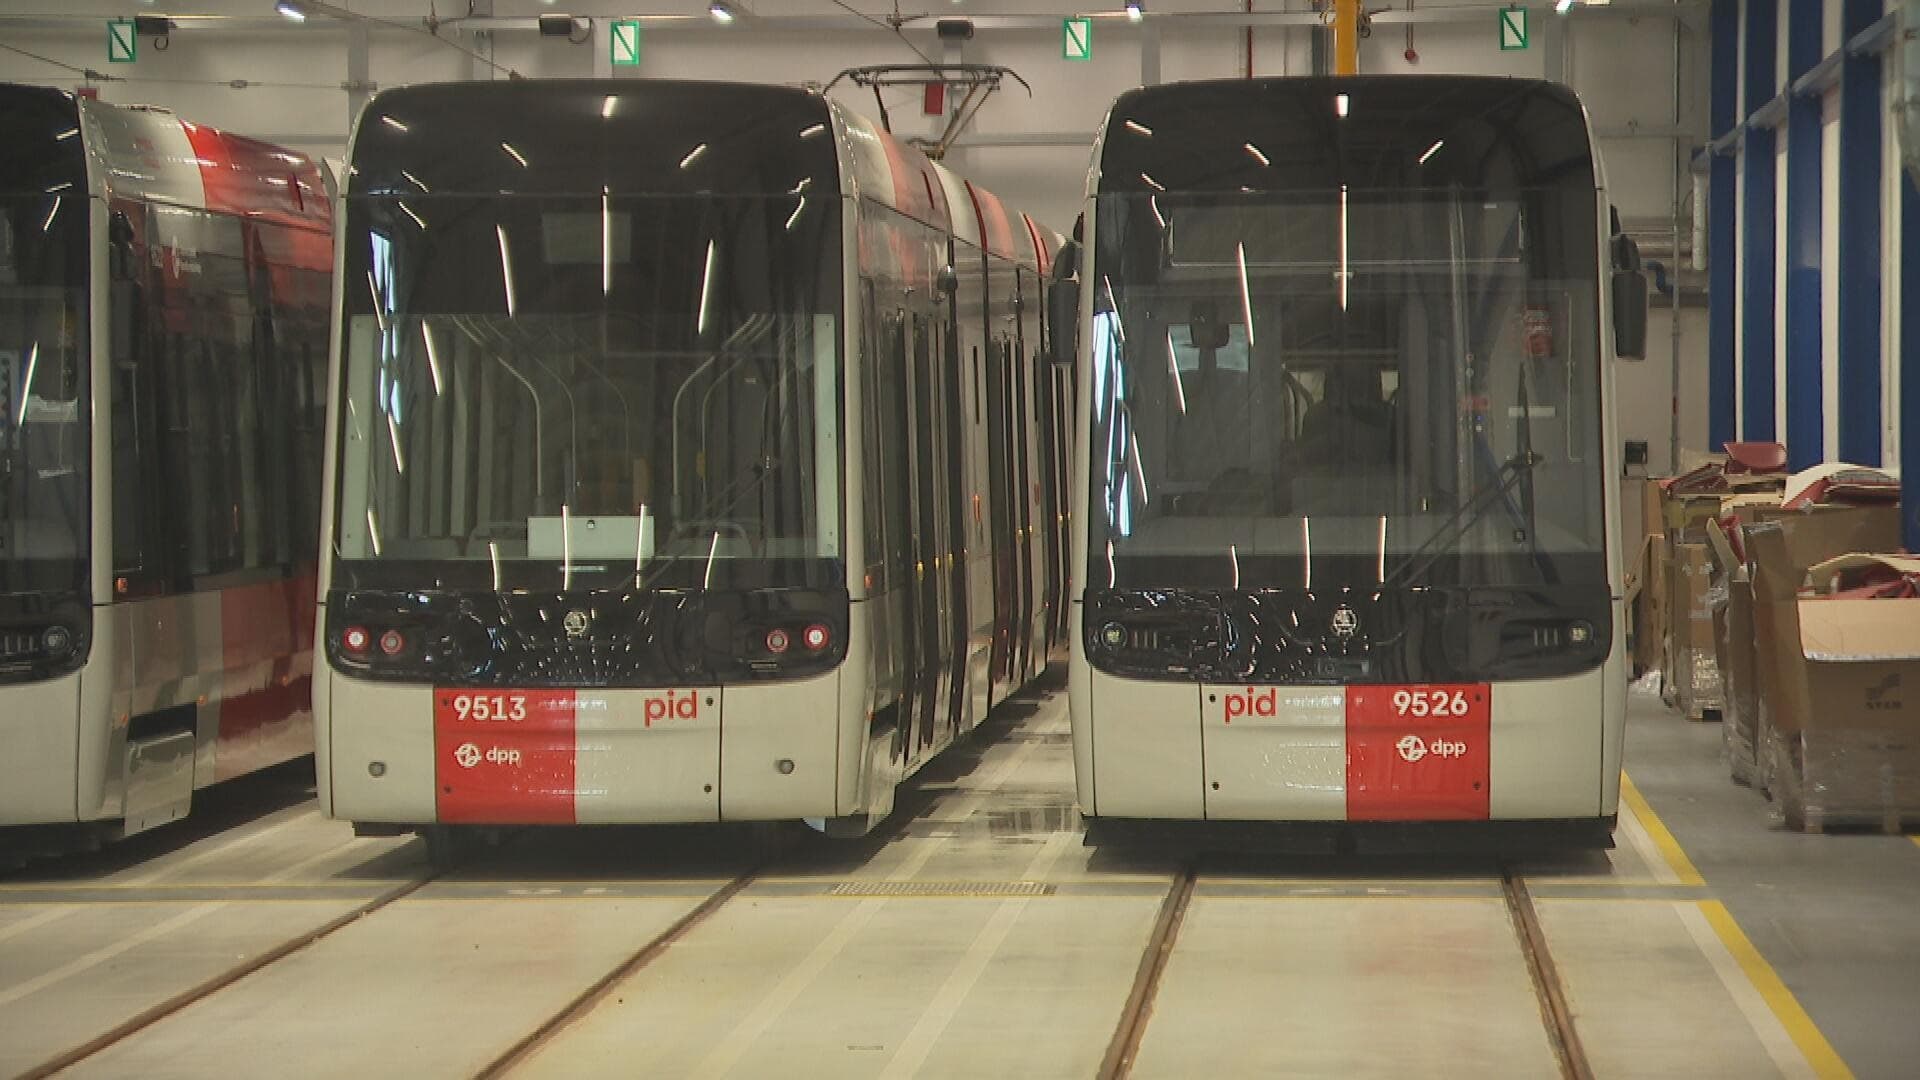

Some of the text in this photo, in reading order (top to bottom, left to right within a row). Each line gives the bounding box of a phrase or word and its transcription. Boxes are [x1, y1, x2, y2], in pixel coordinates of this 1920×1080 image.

[453, 695, 527, 721] 9513
[645, 688, 698, 728] pid
[1224, 687, 1277, 724] pid
[1393, 690, 1469, 717] 9526
[485, 746, 520, 765] dpp
[1430, 738, 1467, 758] dpp
